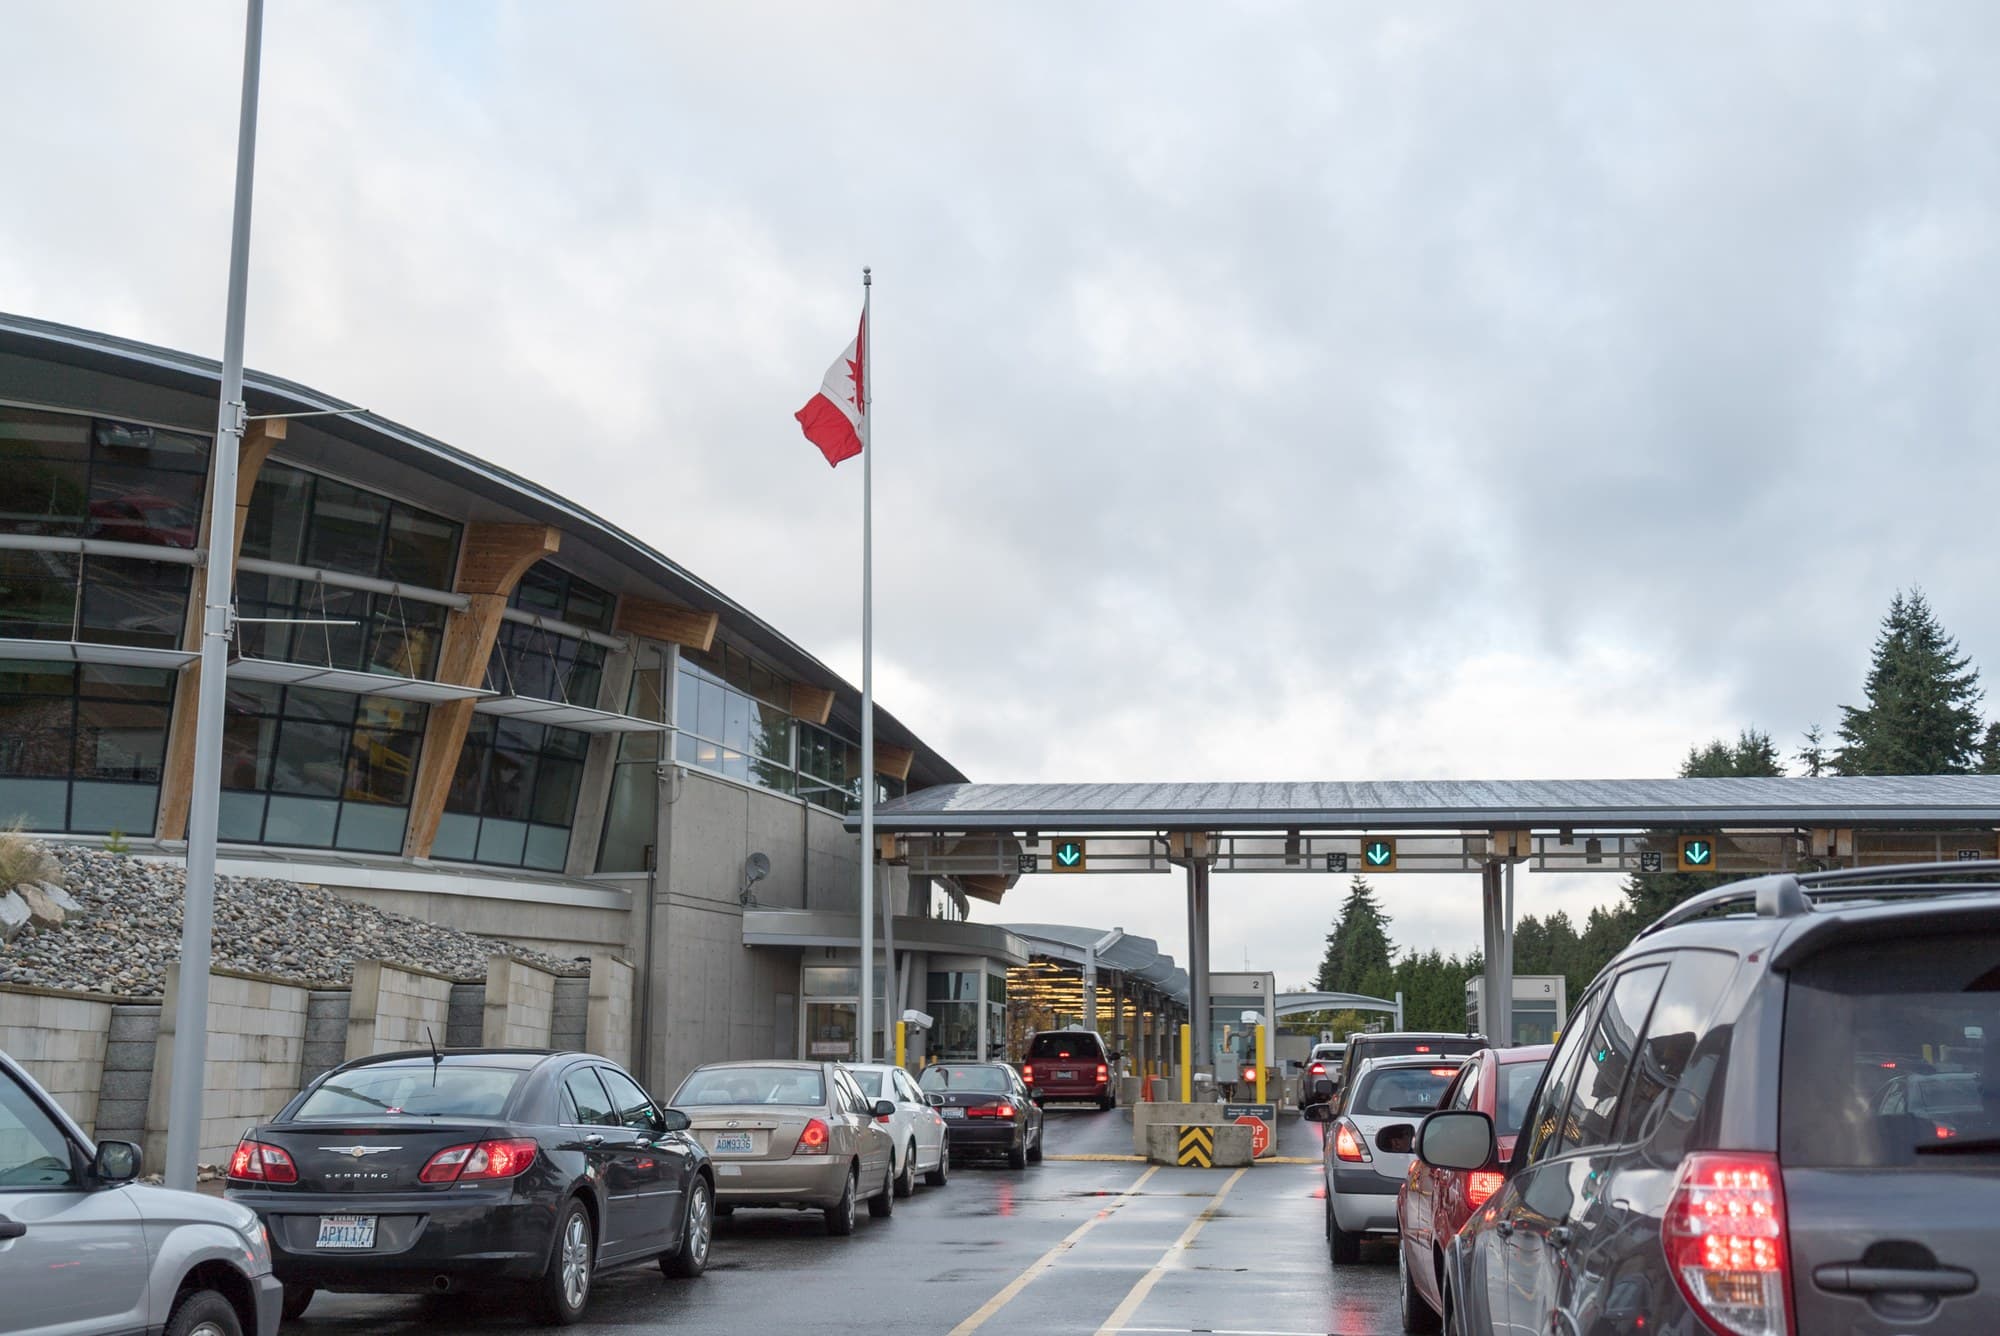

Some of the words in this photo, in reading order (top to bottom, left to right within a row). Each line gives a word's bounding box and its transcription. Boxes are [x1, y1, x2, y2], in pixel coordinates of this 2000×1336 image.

[965, 982, 969, 991] 1
[1252, 981, 1260, 989] 2
[1544, 984, 1550, 993] 3
[320, 1226, 373, 1242] APY1177
